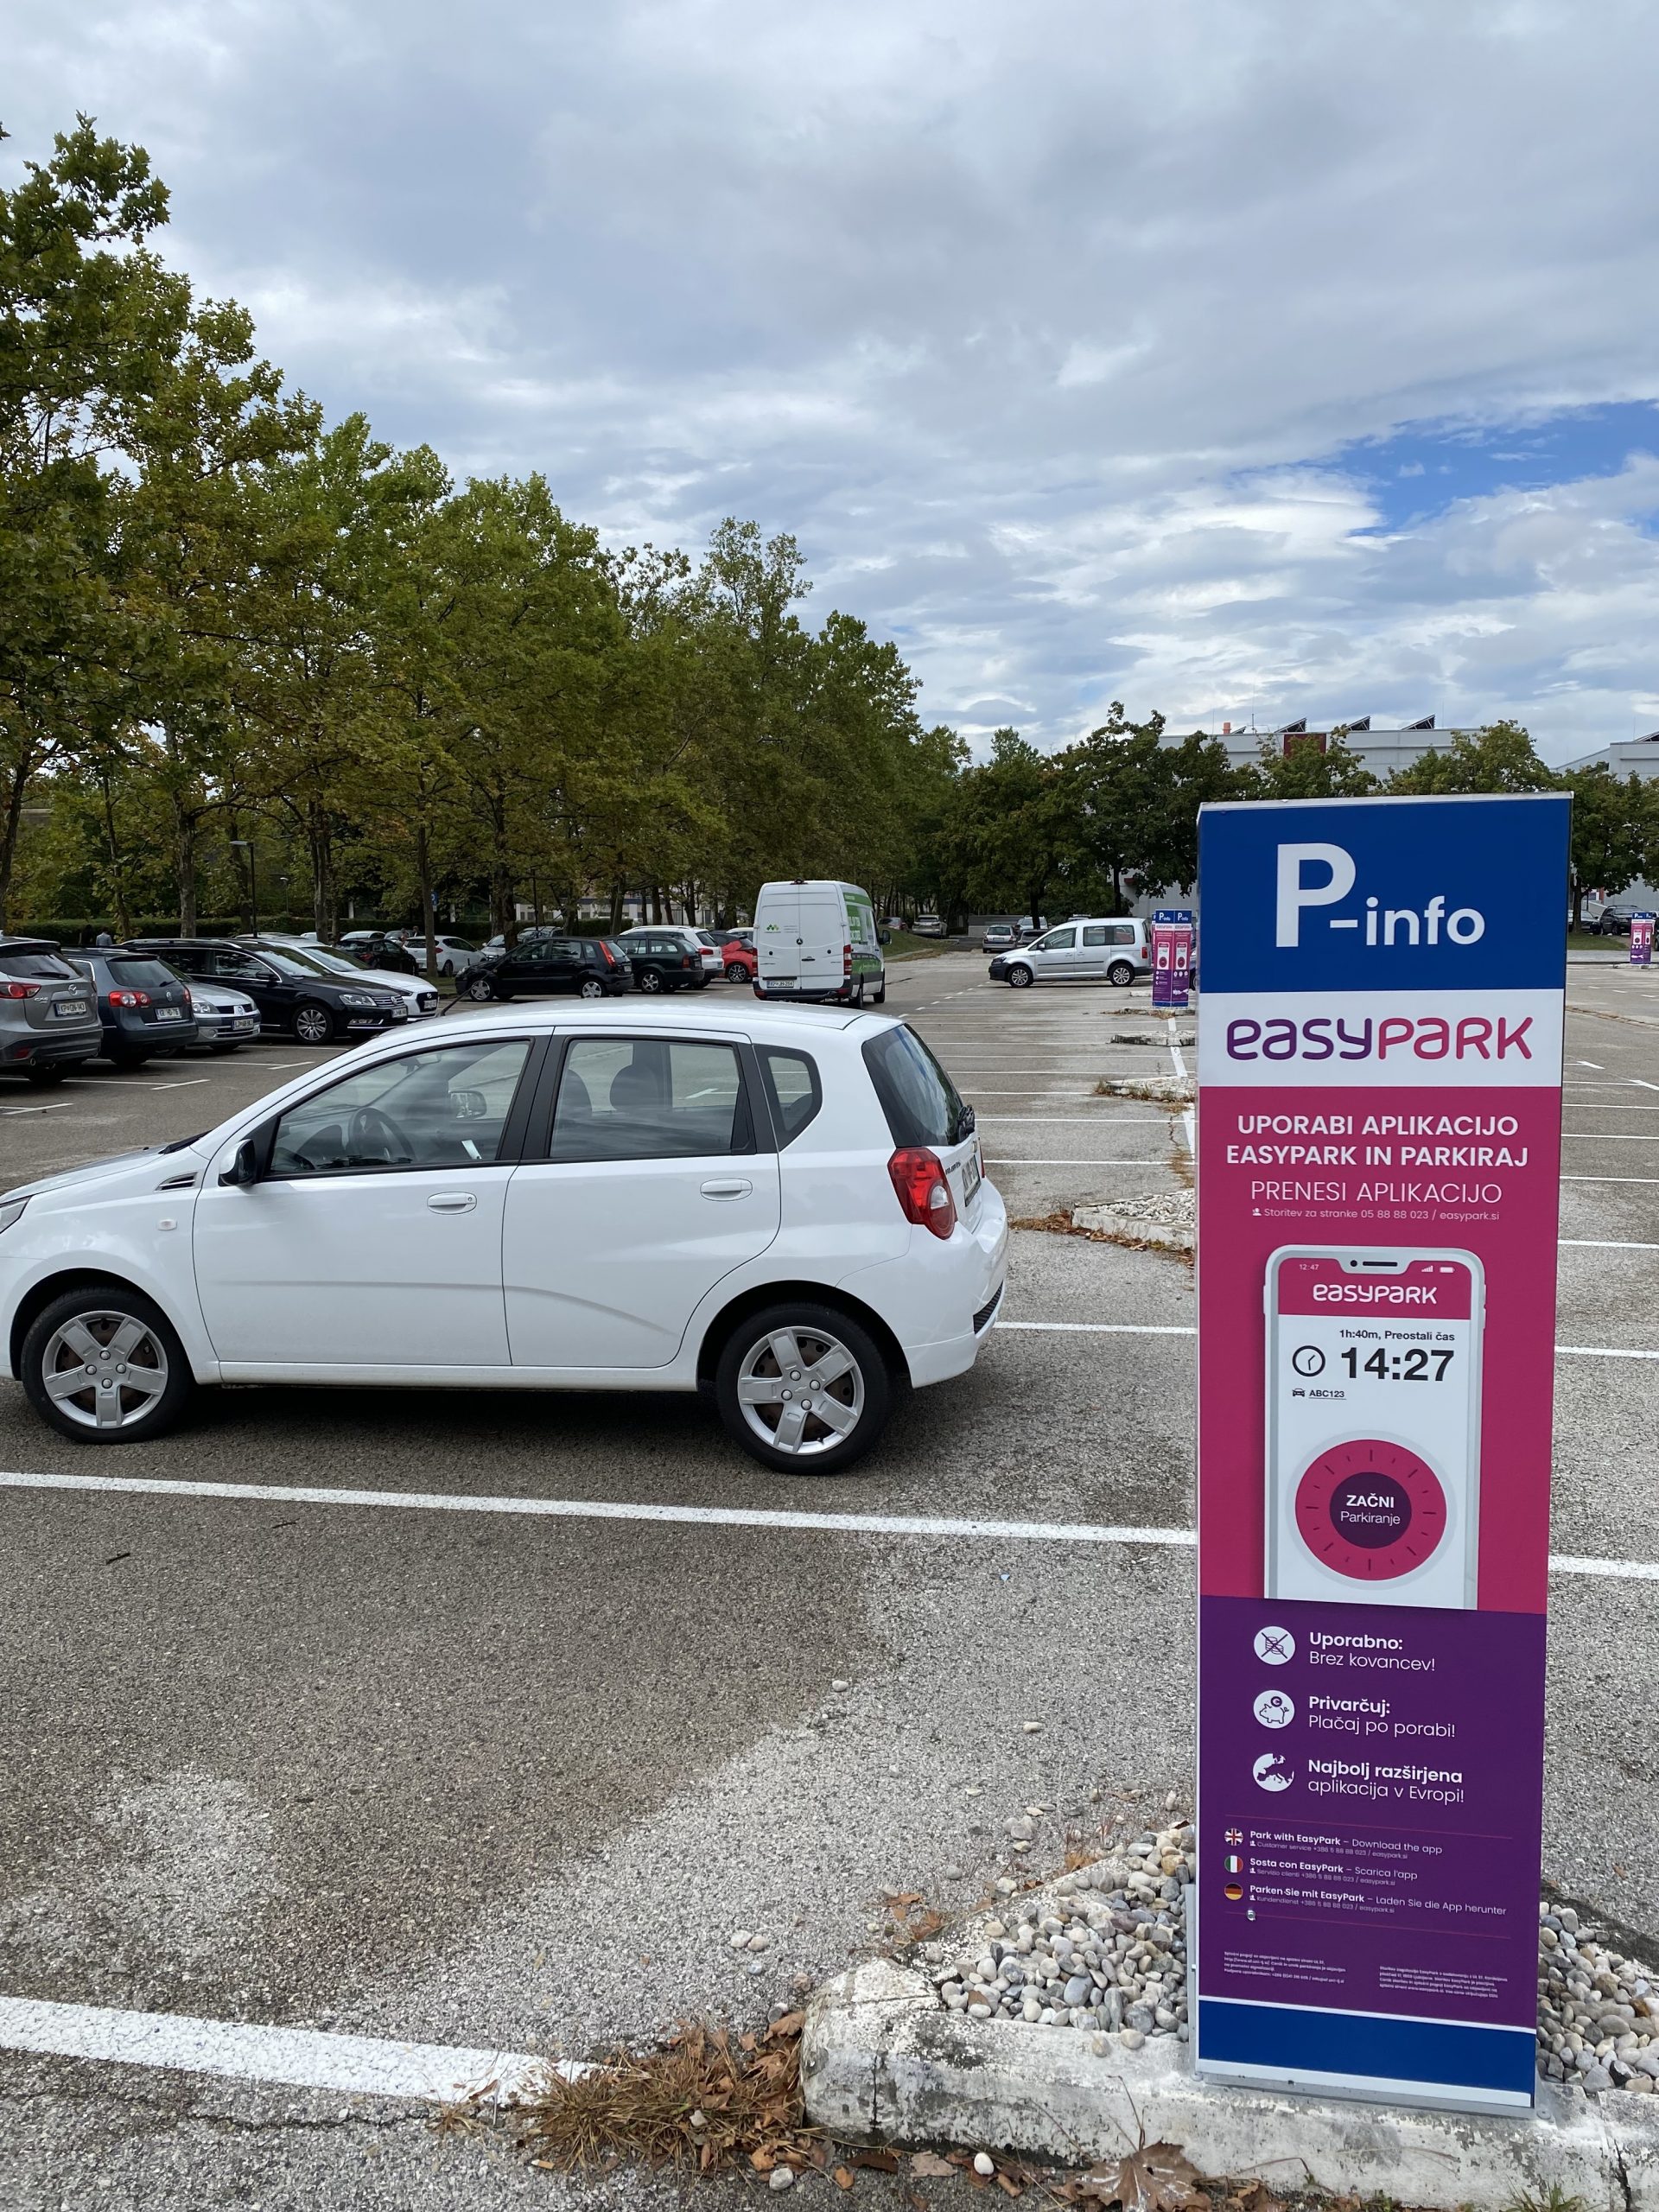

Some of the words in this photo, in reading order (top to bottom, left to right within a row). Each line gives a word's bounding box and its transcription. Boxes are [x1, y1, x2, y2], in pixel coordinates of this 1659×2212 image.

[1276, 843, 1484, 947] P-info
[1238, 1116, 1352, 1135] UPORABI
[1362, 1116, 1518, 1135] APLIKACIJO
[1228, 1146, 1357, 1165] EASYPARK
[1366, 1147, 1391, 1165] IN
[1402, 1147, 1528, 1166] PARKIRAJ
[1252, 1181, 1345, 1200] PRENESI
[1357, 1183, 1502, 1203] APLIKACIJO
[1264, 1208, 1302, 1217] Storitev
[1440, 1211, 1500, 1222] easypark.si
[1340, 1330, 1381, 1340] 1h:40m,
[1385, 1331, 1432, 1340] Preostali
[1342, 1347, 1454, 1381] 14:27
[1309, 1389, 1344, 1398] ABC123
[1346, 1493, 1394, 1508] ZAČNI
[1341, 1511, 1400, 1526] Parkiranje
[1310, 1632, 1402, 1649] Uporabno:
[1310, 1651, 1344, 1665] Brez
[1350, 1653, 1434, 1671] kovancev!
[1309, 1696, 1390, 1717] Privarčuj:
[1310, 1715, 1359, 1734] Plačaj
[1366, 1722, 1388, 1735] po
[1395, 1723, 1454, 1737] porabi!
[1308, 1759, 1370, 1781] Najbolj
[1375, 1765, 1463, 1785] razširjena
[1308, 1781, 1389, 1800] aplikacija
[1395, 1788, 1403, 1797] v
[1410, 1786, 1463, 1805] Evropi!
[1250, 1831, 1272, 1840] Park
[1274, 1833, 1294, 1841] with
[1297, 1834, 1341, 1846] EasyPark
[1352, 1839, 1401, 1851] Download
[1404, 1843, 1420, 1852] the
[1422, 1846, 1443, 1856] app
[1250, 1859, 1277, 1867] Sosta
[1300, 1862, 1344, 1873] EasyPark
[1355, 1867, 1391, 1878] Scarica
[1250, 1885, 1285, 1896] Parken
[1286, 1888, 1300, 1897] Sie
[1302, 1889, 1319, 1898] mit
[1321, 1891, 1365, 1903] EasyPark
[1376, 1897, 1406, 1906] Laden
[1408, 1899, 1422, 1908] Sie
[1425, 1901, 1440, 1910] die
[1443, 1902, 1463, 1912] App
[1465, 1904, 1507, 1916] herunter
